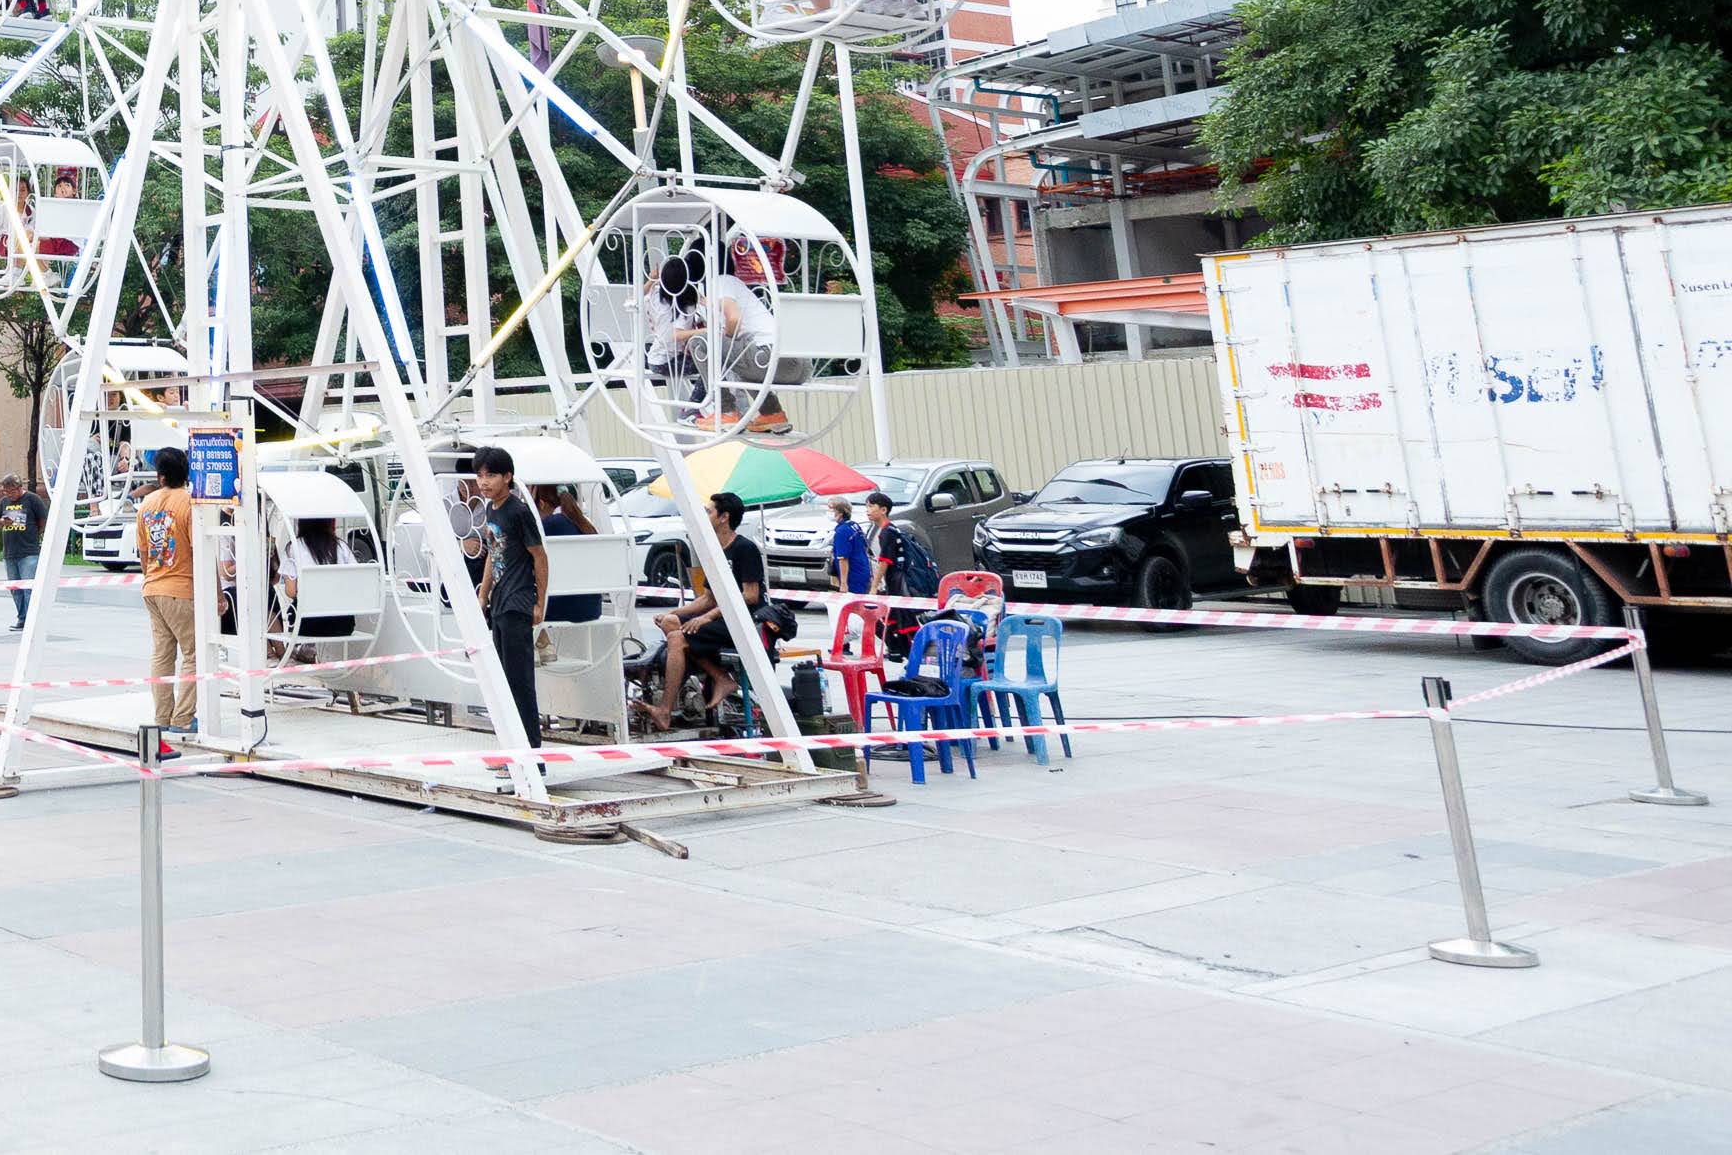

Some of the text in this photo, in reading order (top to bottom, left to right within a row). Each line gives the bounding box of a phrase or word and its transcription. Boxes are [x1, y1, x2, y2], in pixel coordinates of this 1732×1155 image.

[191, 450, 205, 460] 091
[190, 461, 233, 471] 081 5709555
